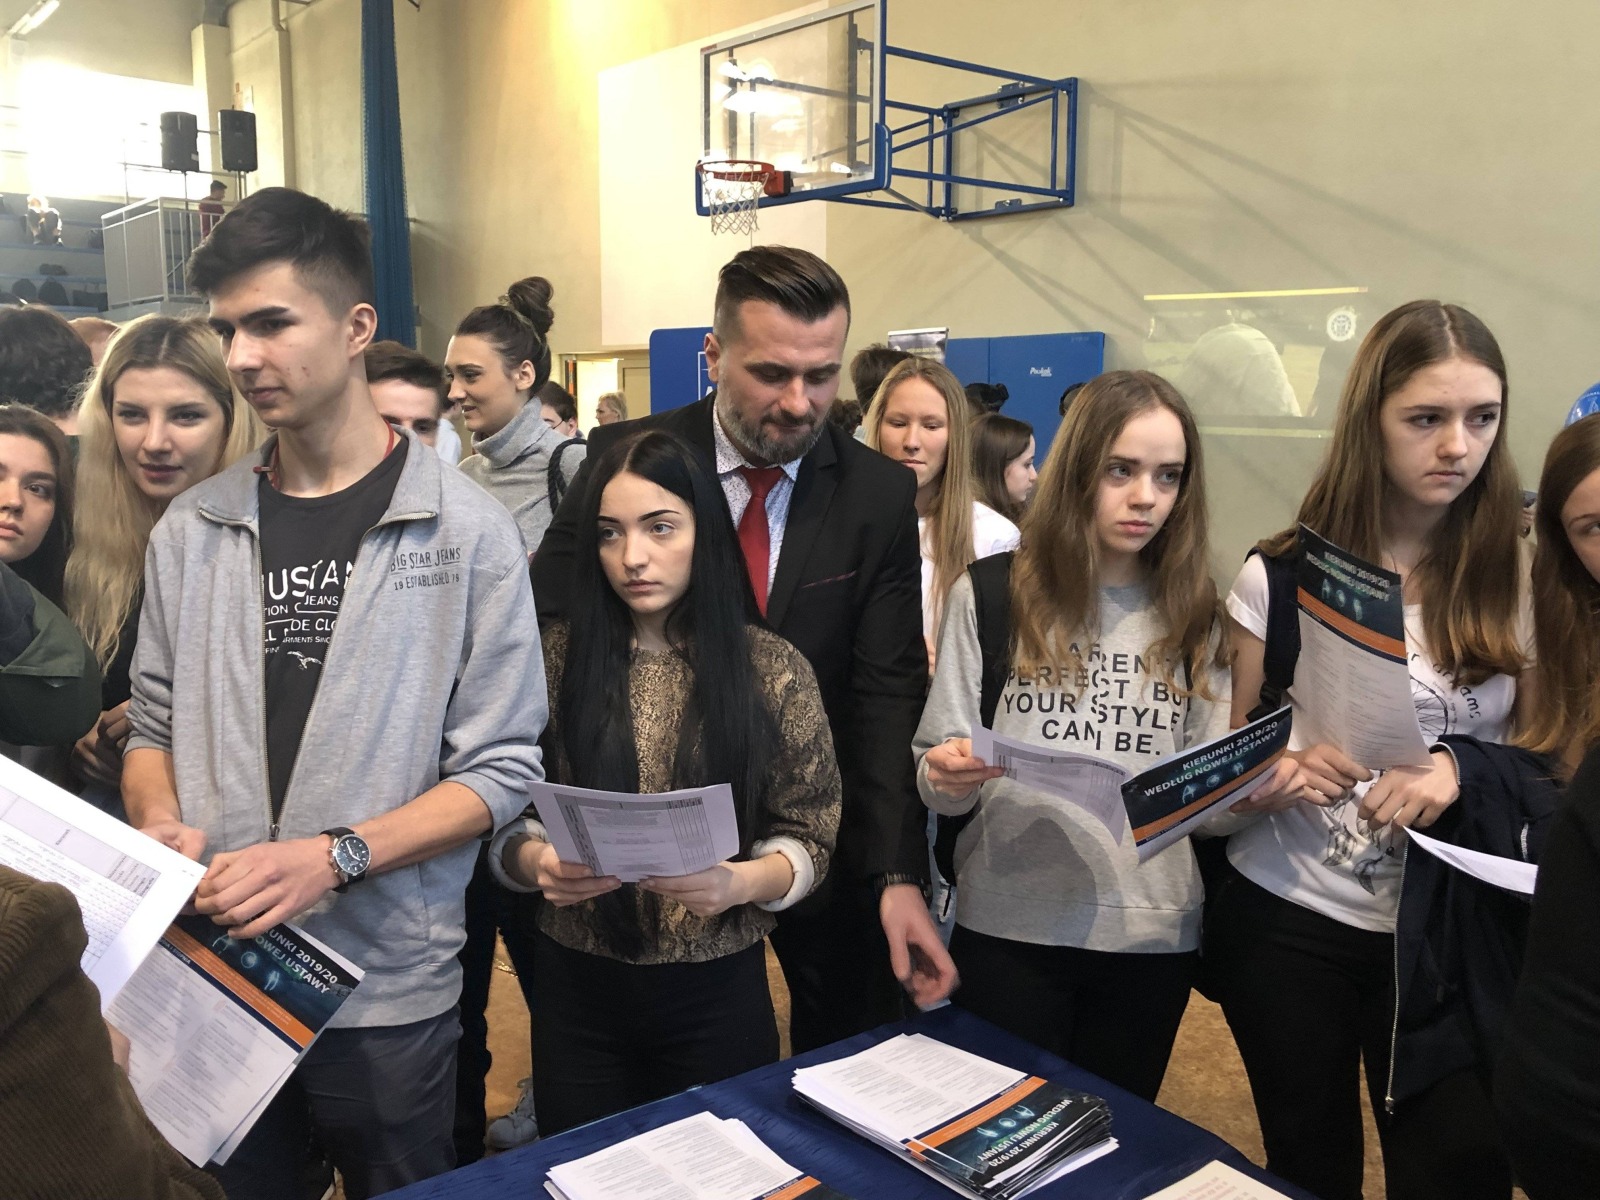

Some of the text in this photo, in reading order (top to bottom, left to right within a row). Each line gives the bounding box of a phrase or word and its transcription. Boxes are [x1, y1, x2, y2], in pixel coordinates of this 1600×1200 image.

[409, 551, 432, 569] STAR
[435, 547, 461, 566] JEANS
[394, 580, 404, 590] 19
[405, 571, 450, 588] ESTABLISHED
[304, 594, 339, 606] JEANS
[1004, 692, 1180, 732] YOUR STYLE
[1041, 719, 1161, 756] CAN BE.
[1182, 721, 1278, 771] KIERUNKI 2019/20
[1143, 729, 1278, 797] WEDŁUG NOWEJ USTAWY
[285, 957, 331, 994] USTAWY
[295, 949, 338, 984] 2019/20
[988, 1121, 1060, 1167] KIERUNKI 2019/20
[1010, 1119, 1042, 1143] NOWEJ
[977, 1138, 1012, 1162] USTAWY
